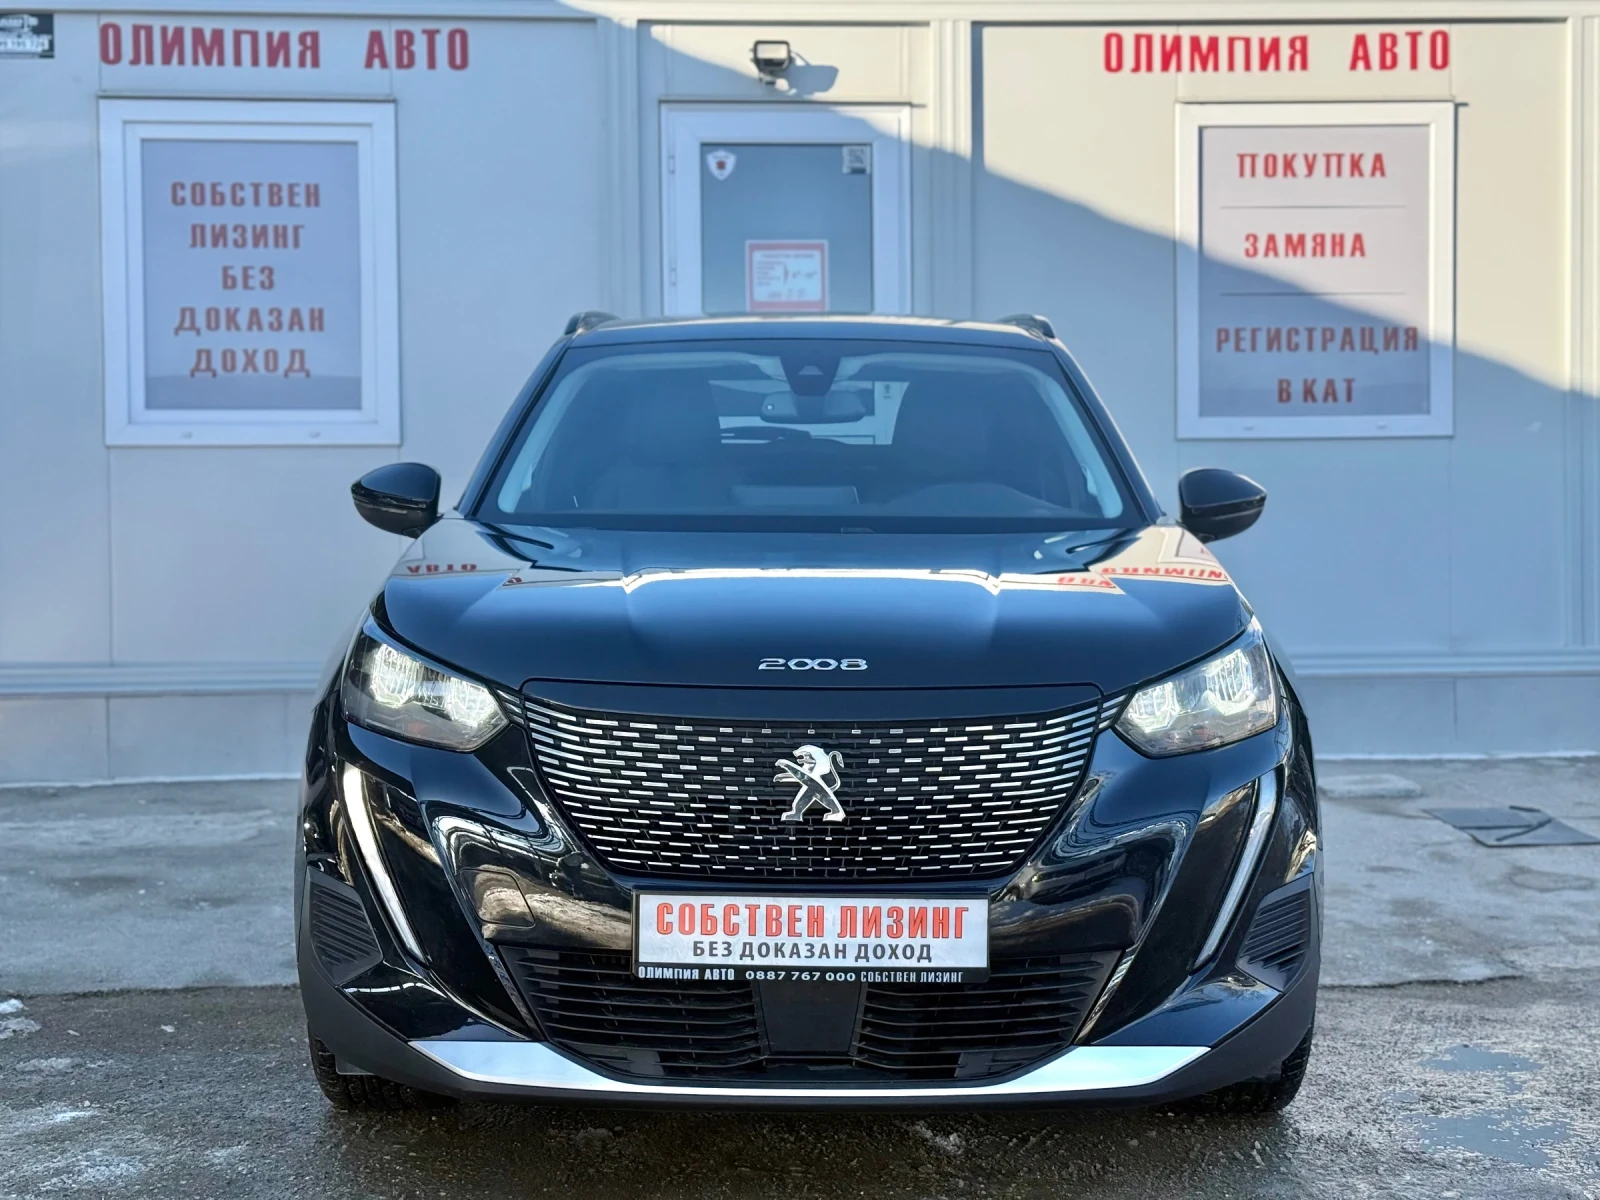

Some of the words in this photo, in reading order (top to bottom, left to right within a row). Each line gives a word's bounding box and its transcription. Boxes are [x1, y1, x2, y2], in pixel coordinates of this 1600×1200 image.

[100, 22, 320, 68] ОЛИМПИЯ
[364, 28, 469, 70] АВТО
[1103, 32, 1309, 73] ОЛИМПИЯ
[1350, 30, 1450, 71] АВТО
[1237, 153, 1386, 178] ПОКУПКА
[171, 182, 320, 207] СОБСТВЕН
[189, 224, 304, 249] ЛИЗИНГ
[1244, 234, 1366, 258] ЗАМЯНА
[221, 265, 275, 290] БЕЗ
[174, 307, 324, 335] ДОКАЗАН
[1216, 327, 1418, 355] РЕГИСТРАЦИЯ
[190, 349, 310, 377] ДОХОД
[1303, 378, 1356, 403] КАТ
[758, 657, 868, 671] 2008
[656, 902, 825, 938] СОБСТВЕН
[837, 906, 969, 939] ЛИЗИНГ
[693, 941, 733, 957] БЕЗ
[739, 942, 847, 962] ДОКАЗАН
[855, 944, 932, 963] ДОХОД
[638, 966, 699, 980] ОЛИМПИЯ
[704, 969, 735, 981] АВТО
[745, 971, 786, 980] 0887
[791, 972, 821, 981] 767
[825, 972, 856, 982] 000
[860, 971, 916, 983] СОБСТВЕН
[920, 972, 964, 983] ЛИЗИНГ
